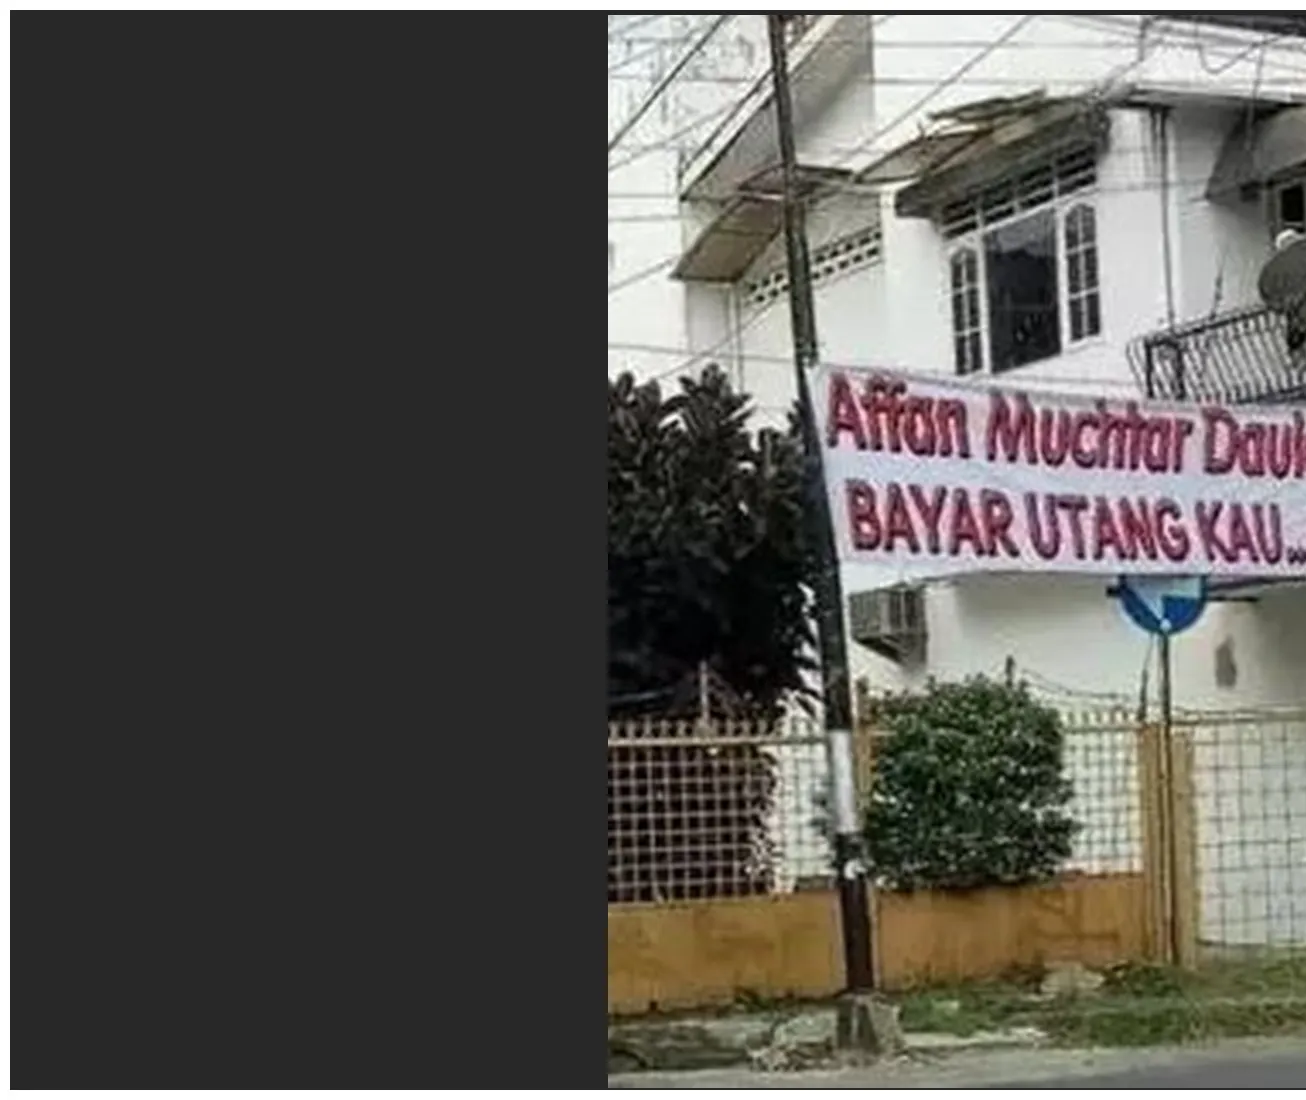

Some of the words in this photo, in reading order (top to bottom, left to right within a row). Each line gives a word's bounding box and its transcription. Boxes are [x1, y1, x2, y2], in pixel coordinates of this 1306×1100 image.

[826, 371, 969, 459] Affan
[986, 388, 1194, 475] Muchtar
[845, 480, 1019, 557] BAYAR
[1023, 493, 1190, 561] UTANG
